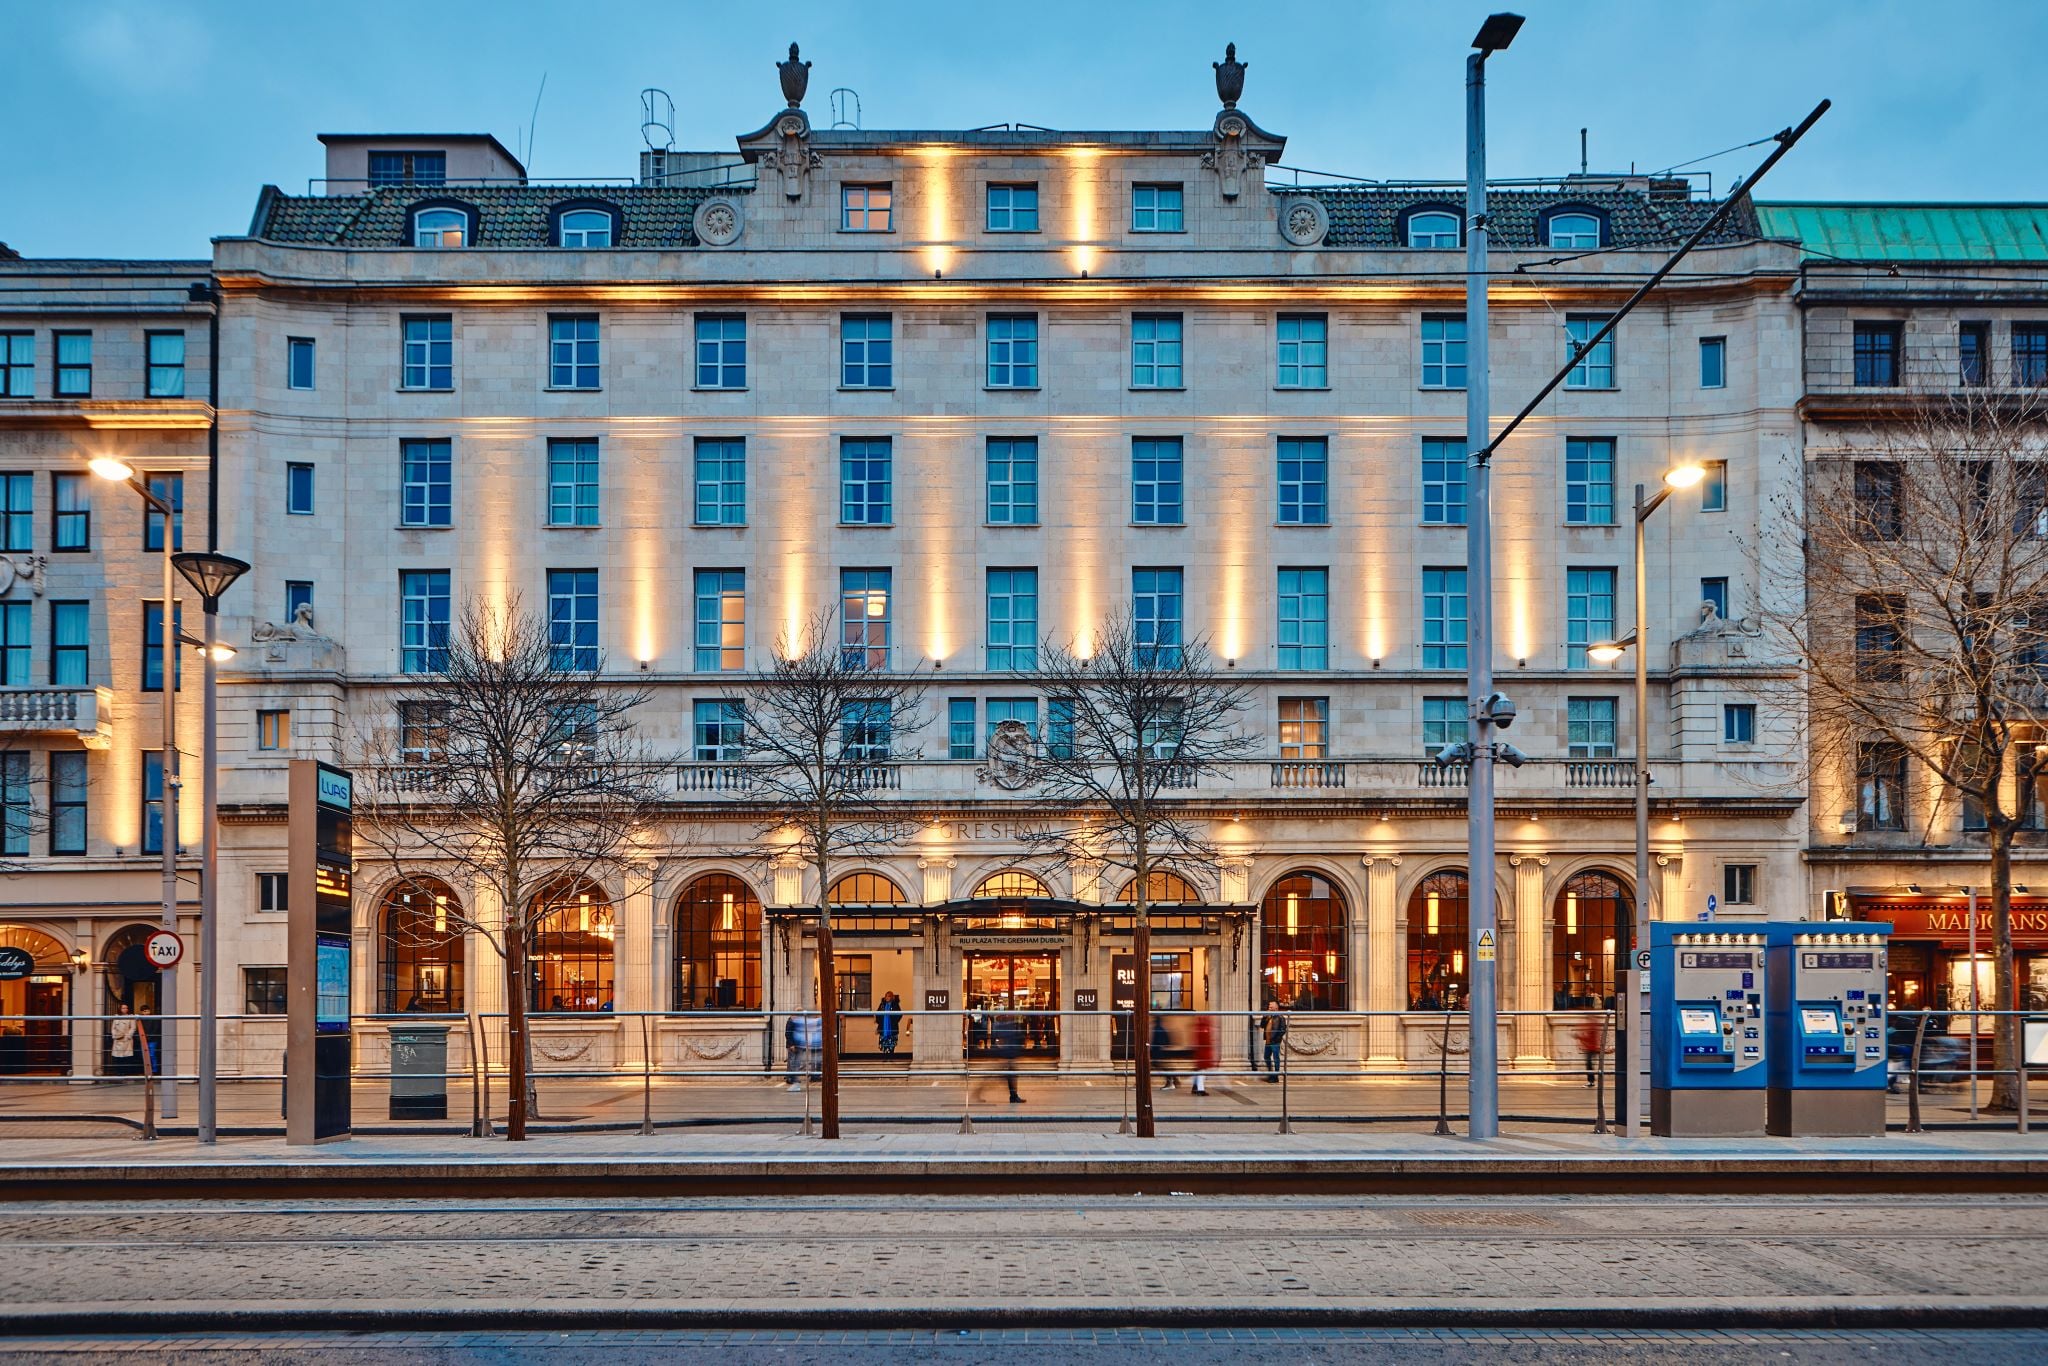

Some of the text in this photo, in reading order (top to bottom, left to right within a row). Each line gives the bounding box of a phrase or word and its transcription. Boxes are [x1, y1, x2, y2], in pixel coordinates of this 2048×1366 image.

[321, 777, 348, 800] LUAS
[868, 823, 1051, 839] THE GRESHAM
[151, 946, 177, 957] TAXI
[928, 995, 946, 1004] RIU
[1077, 994, 1095, 1004] RIU
